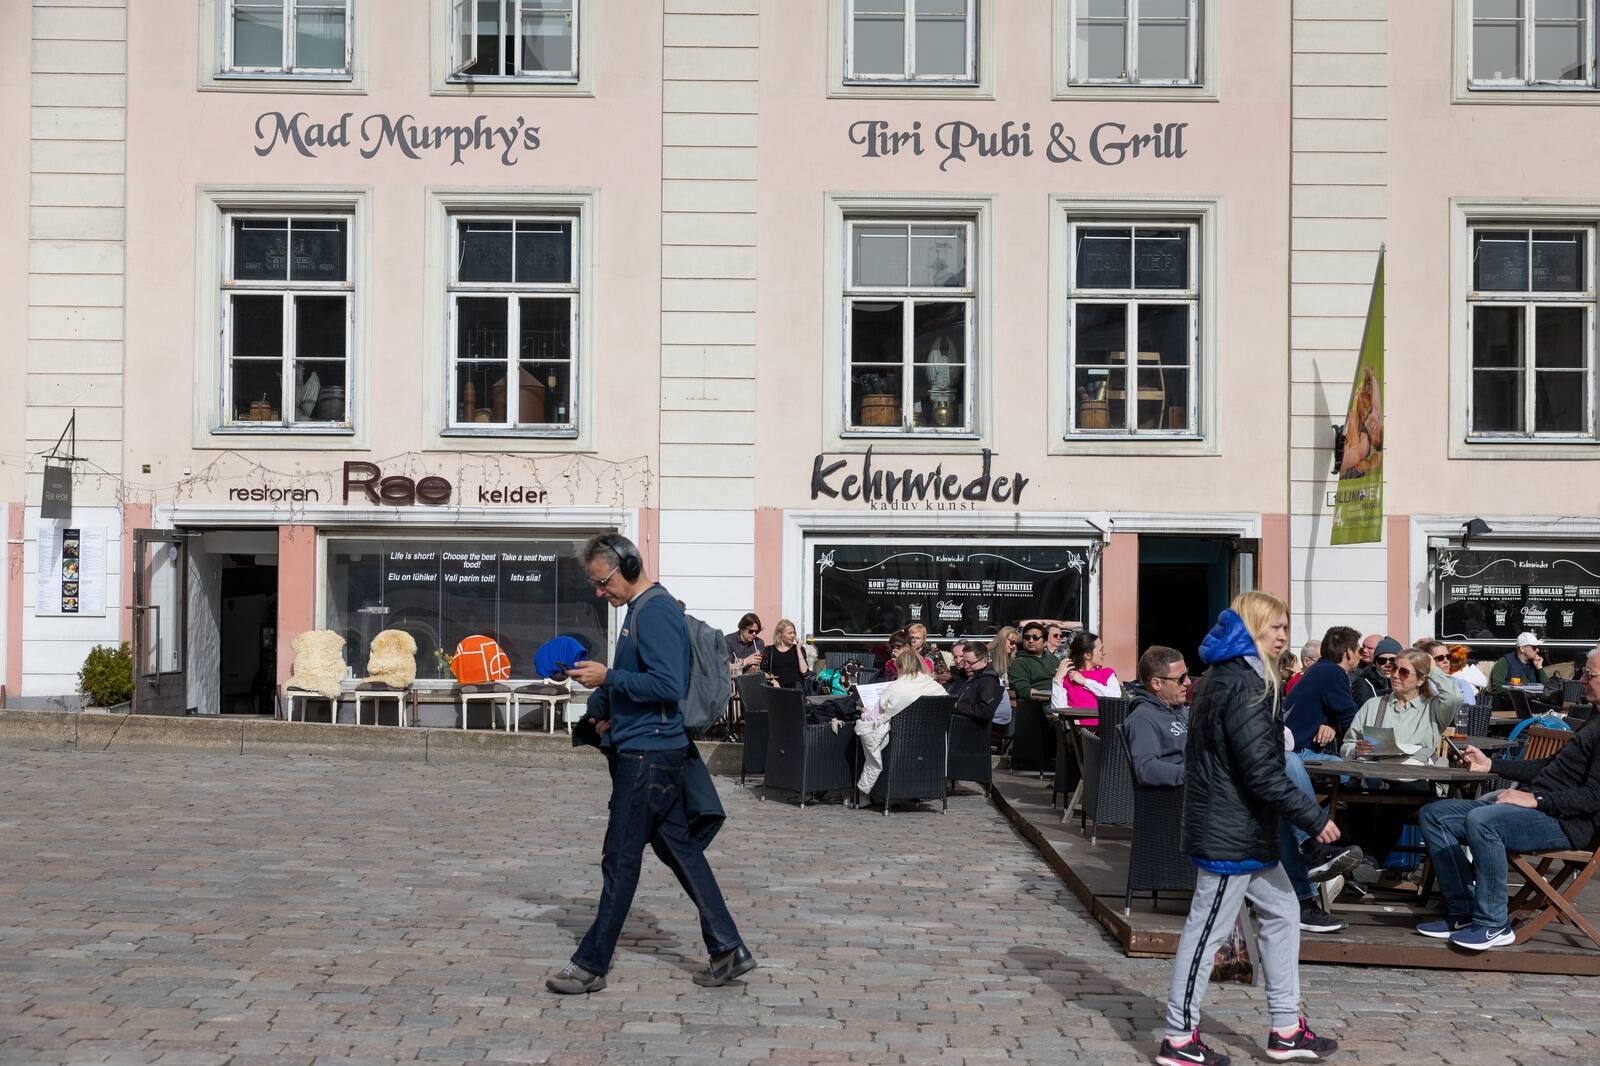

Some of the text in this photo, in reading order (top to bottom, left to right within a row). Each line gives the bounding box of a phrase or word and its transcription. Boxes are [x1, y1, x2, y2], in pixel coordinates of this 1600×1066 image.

[254, 111, 541, 166] Mad Murphy's
[848, 120, 1189, 172] Tiri Pubi & Grill
[811, 444, 1030, 506] Kehrwieder
[229, 460, 548, 506] restoran Rae kelder
[870, 499, 976, 512] kaduv kunst
[390, 552, 435, 560] Life is short!
[442, 552, 496, 561] Choose the best
[502, 553, 516, 561] Take
[538, 553, 556, 562] here!
[463, 561, 481, 569] food!
[388, 573, 400, 581] Elu
[444, 574, 496, 583] Vali parim toit!
[511, 574, 541, 582] Istu siia!
[946, 582, 980, 590] SHOKOLAAD
[1529, 587, 1563, 595] SHOKOLAAD
